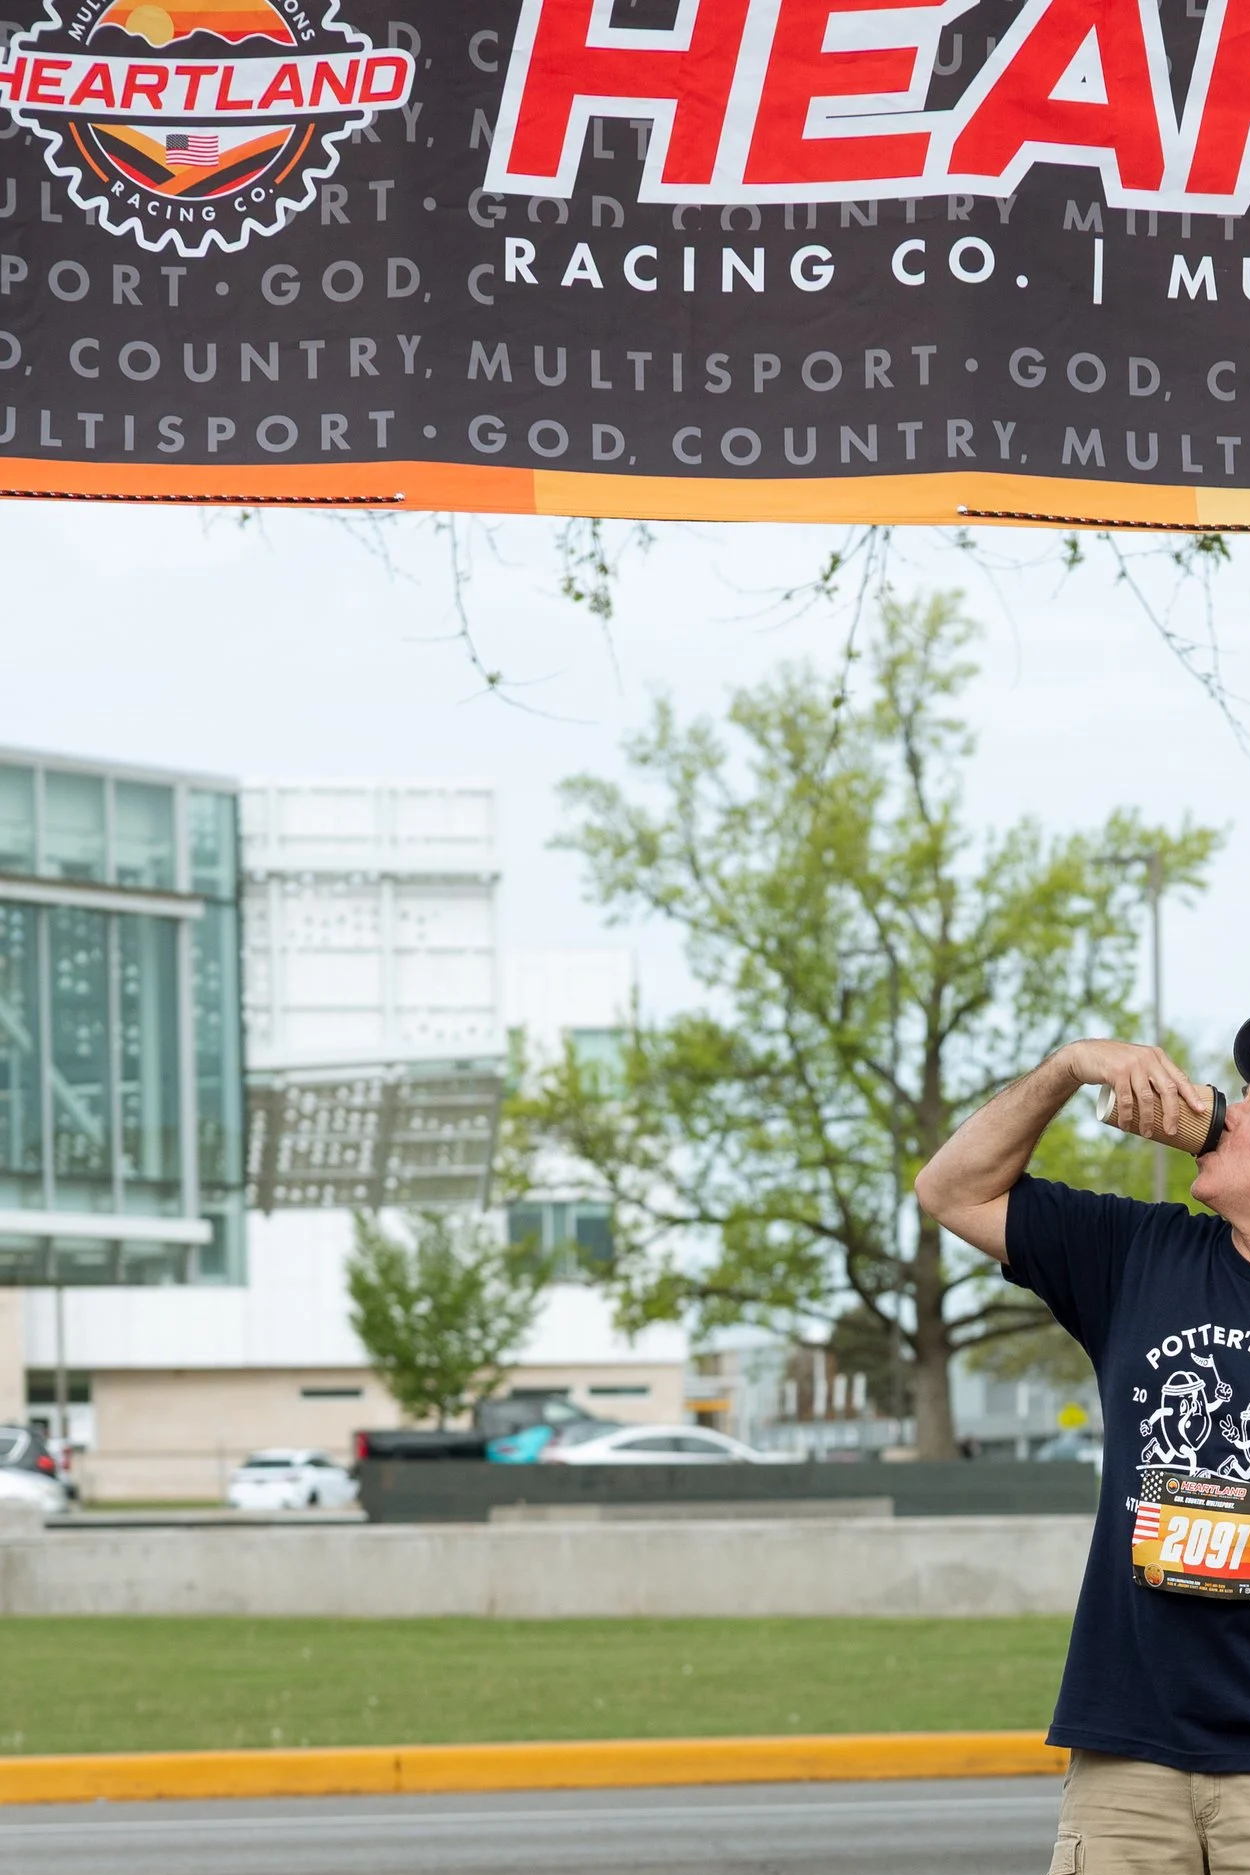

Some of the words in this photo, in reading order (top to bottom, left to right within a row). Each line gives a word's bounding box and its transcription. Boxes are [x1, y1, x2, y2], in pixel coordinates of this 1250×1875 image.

[110, 180, 216, 223] RACING
[234, 187, 274, 212] CO.
[261, 257, 431, 305] GOD,
[504, 237, 835, 293] RACING
[891, 236, 1029, 288] CO.
[69, 334, 432, 382] COUNTRY,
[467, 340, 937, 394] MULTISPORT
[1009, 347, 1171, 402] GOD,
[468, 414, 636, 466] GOD,
[672, 419, 1027, 466] COUNTRY,
[1133, 1387, 1148, 1403] 20
[1181, 1480, 1248, 1498] HEARTLAND
